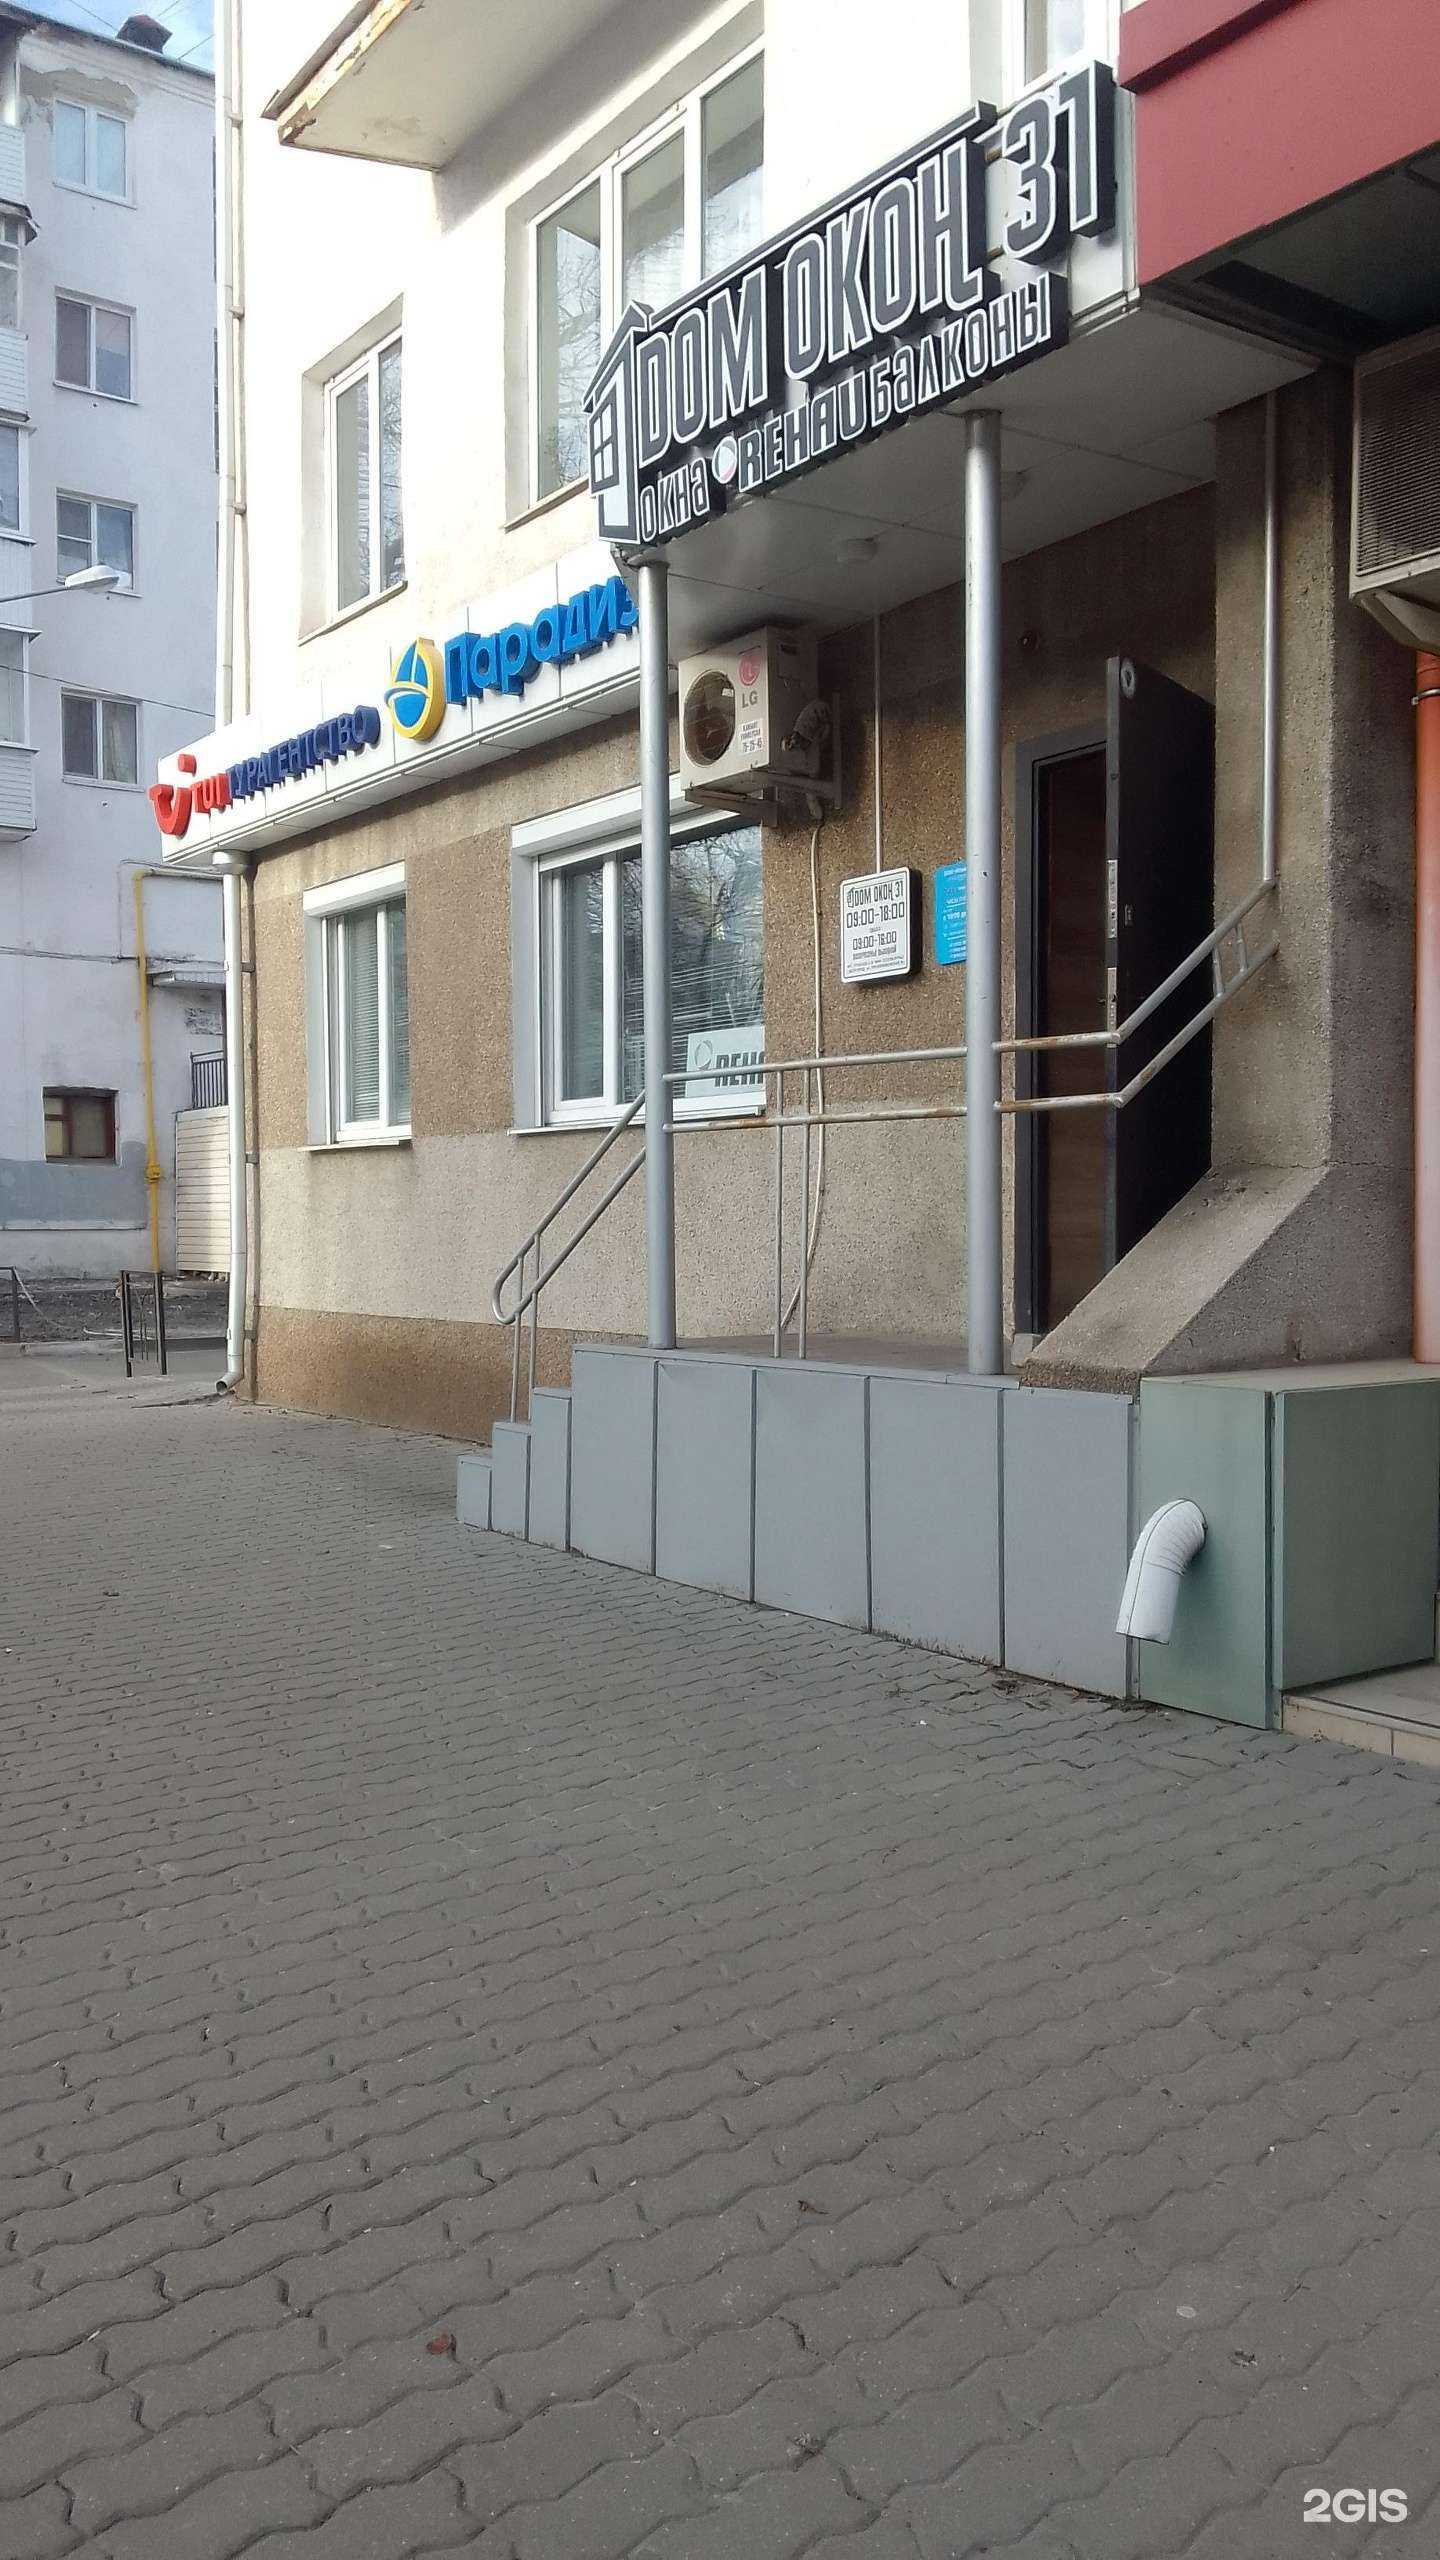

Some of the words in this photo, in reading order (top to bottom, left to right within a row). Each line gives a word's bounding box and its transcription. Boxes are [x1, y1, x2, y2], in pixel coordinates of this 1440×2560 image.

[1002, 60, 1098, 258] 31
[738, 371, 867, 493] REHAU
[741, 690, 759, 709] LG
[225, 705, 381, 800] ТУРАГЕНТСТВО
[895, 880, 904, 898] 31
